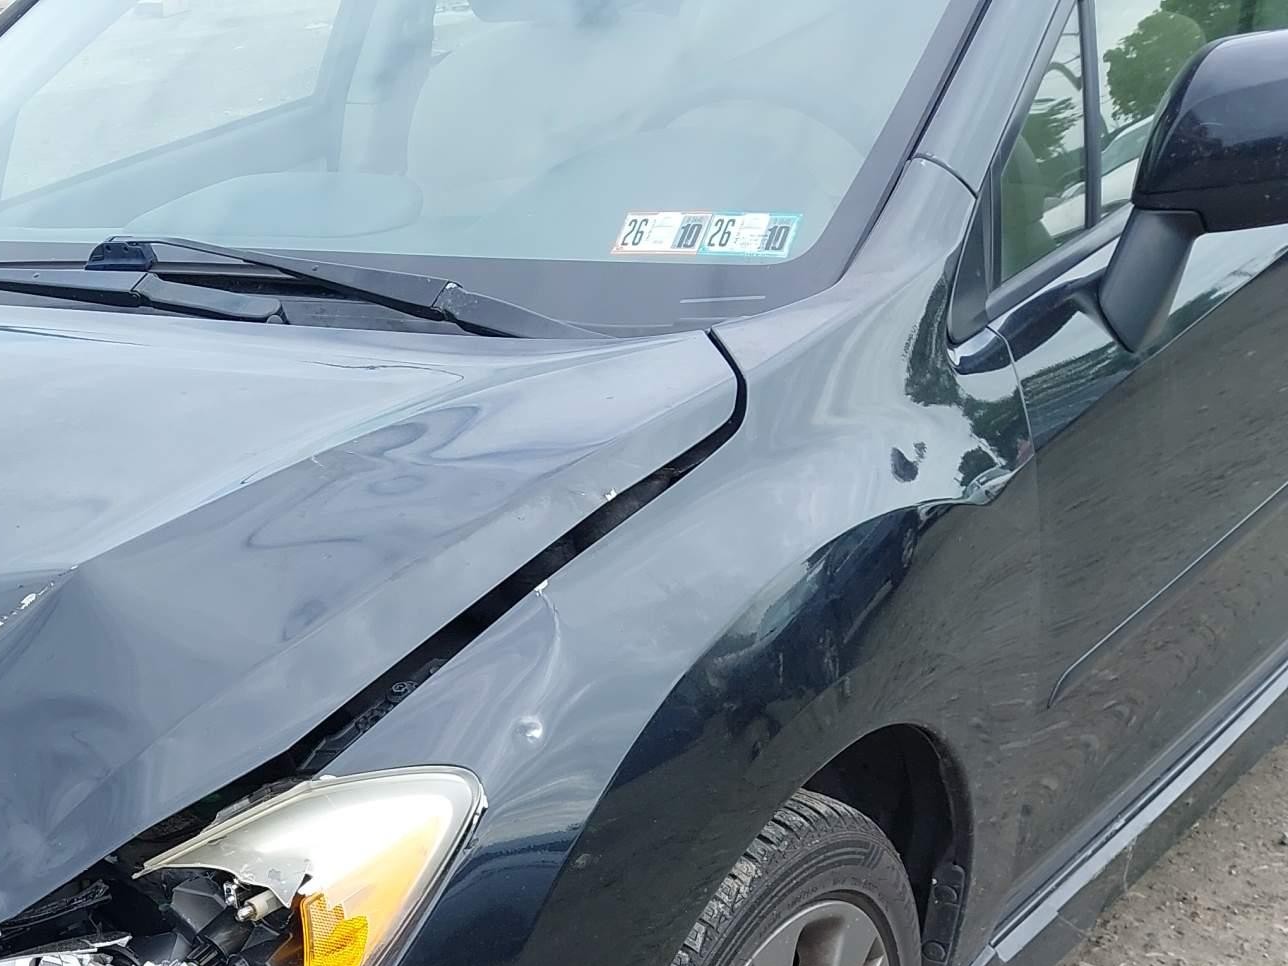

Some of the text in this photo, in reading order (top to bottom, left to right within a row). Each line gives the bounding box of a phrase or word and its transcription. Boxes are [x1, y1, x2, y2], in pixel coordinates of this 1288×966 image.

[620, 218, 649, 246] 26
[676, 223, 703, 249] 10
[707, 218, 736, 247] 26
[764, 225, 791, 251] 10
